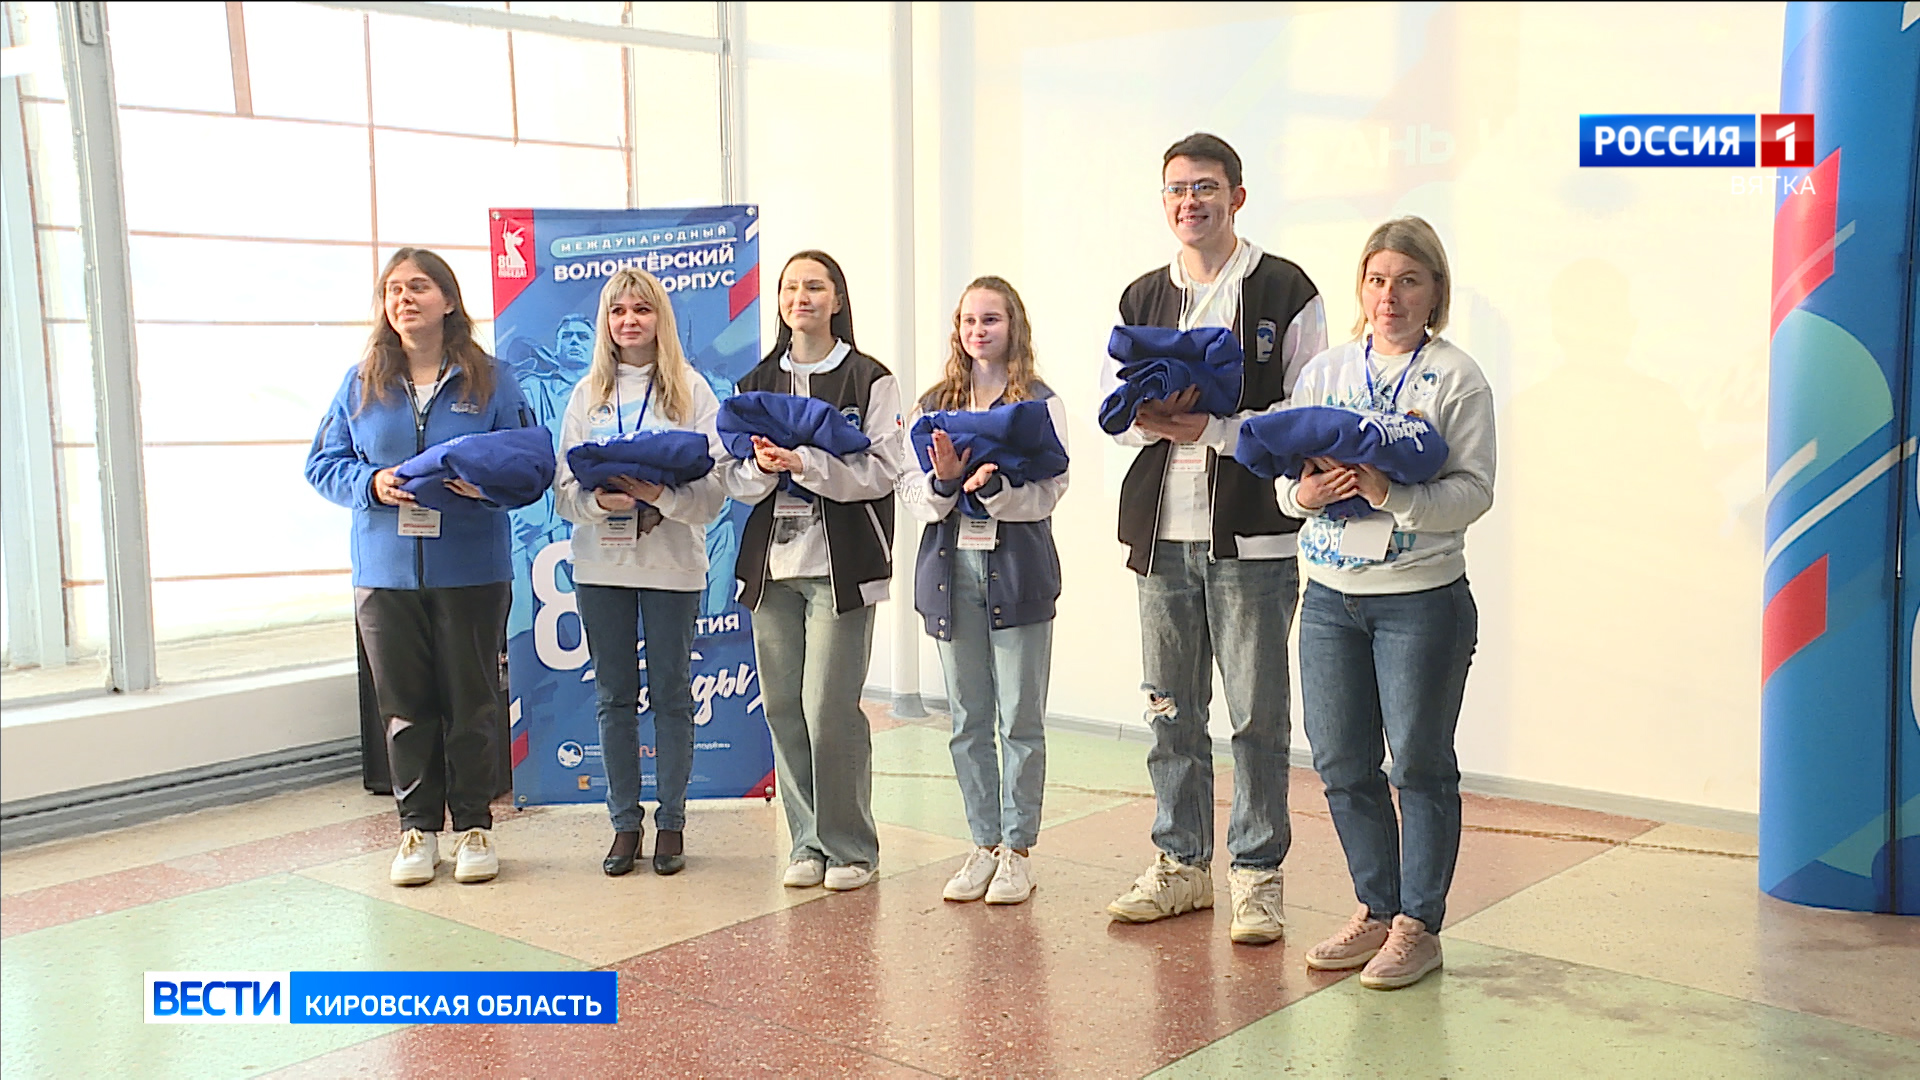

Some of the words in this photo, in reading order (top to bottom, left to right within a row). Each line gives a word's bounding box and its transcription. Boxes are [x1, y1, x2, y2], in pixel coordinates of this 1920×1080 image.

[560, 224, 728, 252] МЕЖДУНАРОДНЫЙ
[554, 243, 735, 282] ВОЛОНТЁРСКИЙ
[657, 270, 737, 293] ОРПУС
[532, 540, 591, 671] 8
